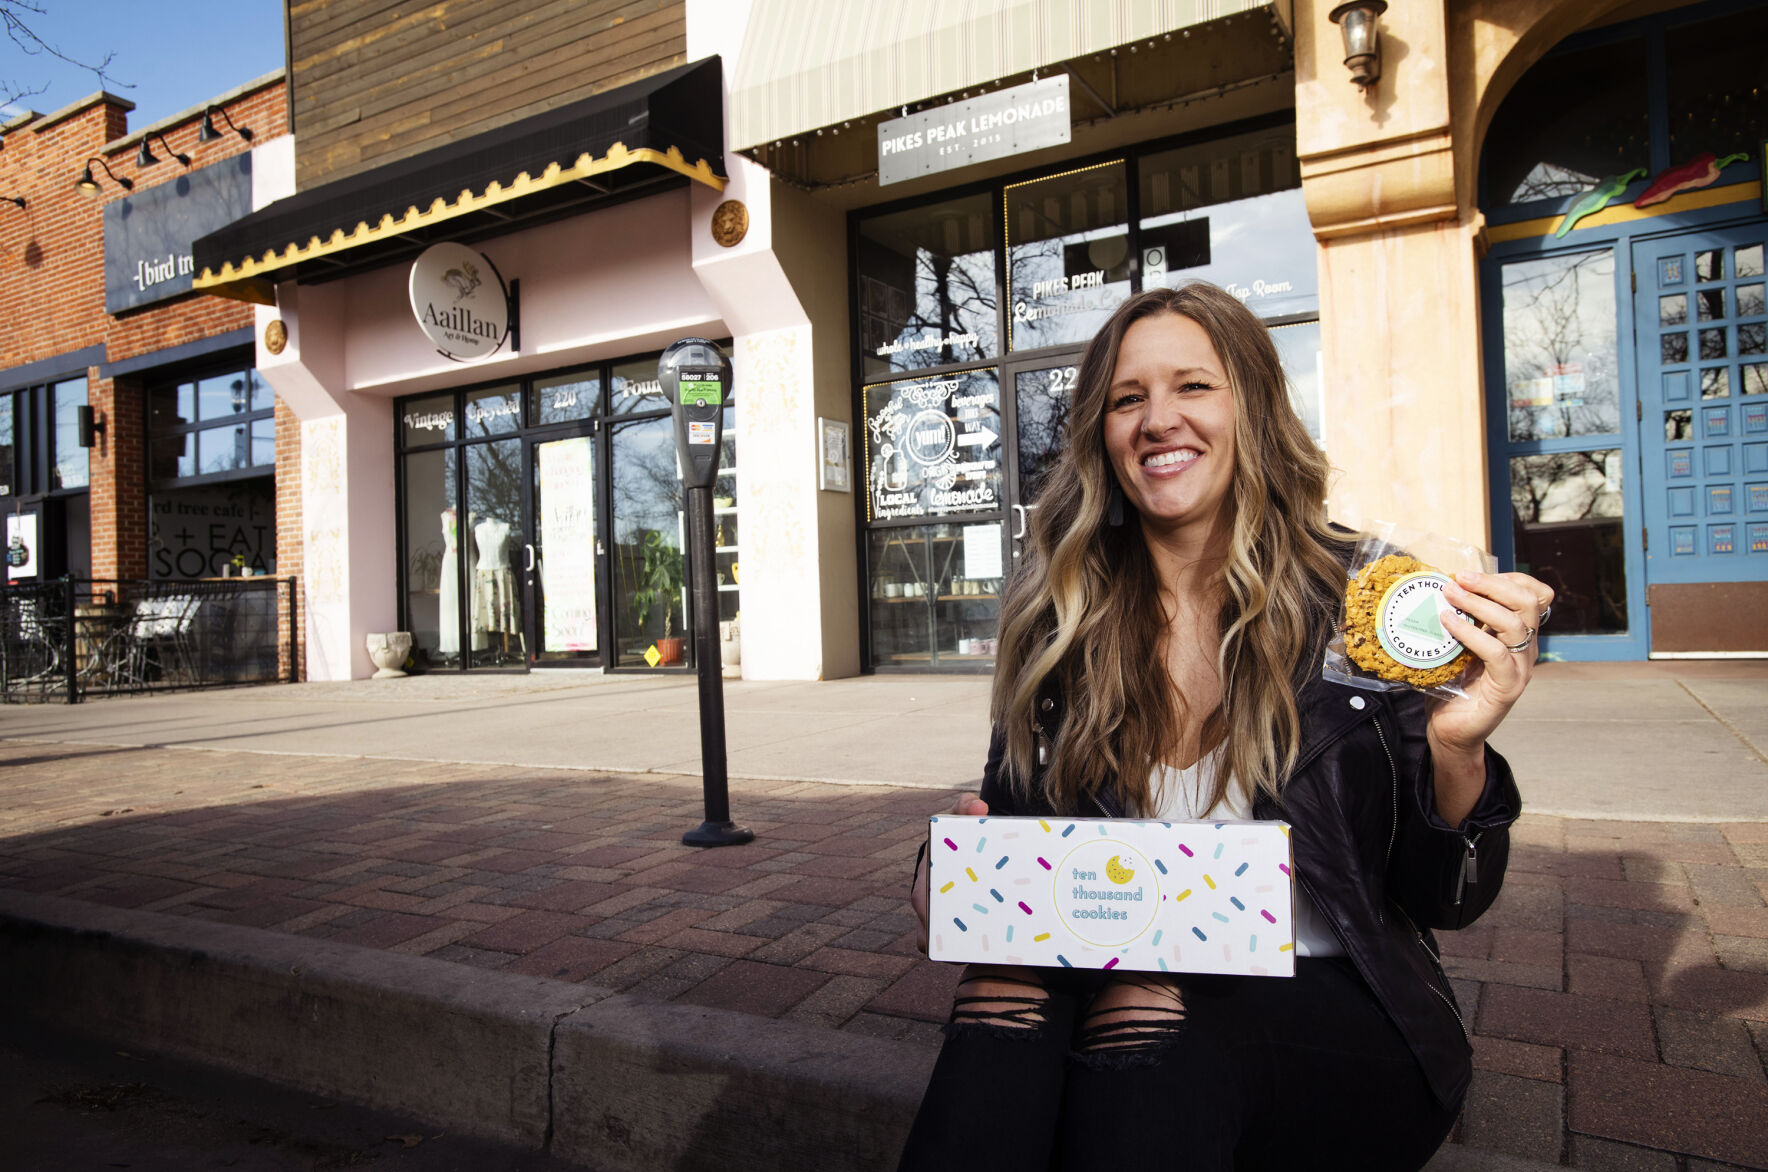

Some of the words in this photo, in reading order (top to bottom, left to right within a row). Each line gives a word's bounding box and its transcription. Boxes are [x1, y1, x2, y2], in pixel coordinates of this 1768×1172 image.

[881, 131, 923, 156] PIKES
[926, 120, 967, 145] PEAK
[971, 96, 1065, 133] LEMONADE
[1033, 277, 1069, 300] PIKES
[1072, 270, 1105, 293] PEAK
[1252, 279, 1292, 297] Room
[422, 302, 498, 340] Aaillan
[948, 331, 979, 349] happy
[951, 393, 995, 408] beverages
[404, 410, 454, 431] Vintage
[554, 389, 577, 409] 220
[915, 425, 947, 449] yum!
[880, 492, 918, 506] LOCAL
[930, 482, 994, 506] lemonade
[177, 501, 208, 515] tree
[213, 503, 245, 517] cafe
[878, 502, 925, 520] ingredients
[208, 523, 268, 552] EAT
[155, 548, 269, 578] SOCA
[1397, 584, 1416, 599] TEN
[1393, 636, 1441, 658] COOKIES
[1072, 867, 1097, 881] ten
[1072, 884, 1143, 902] thousand
[1072, 904, 1128, 921] cookies
